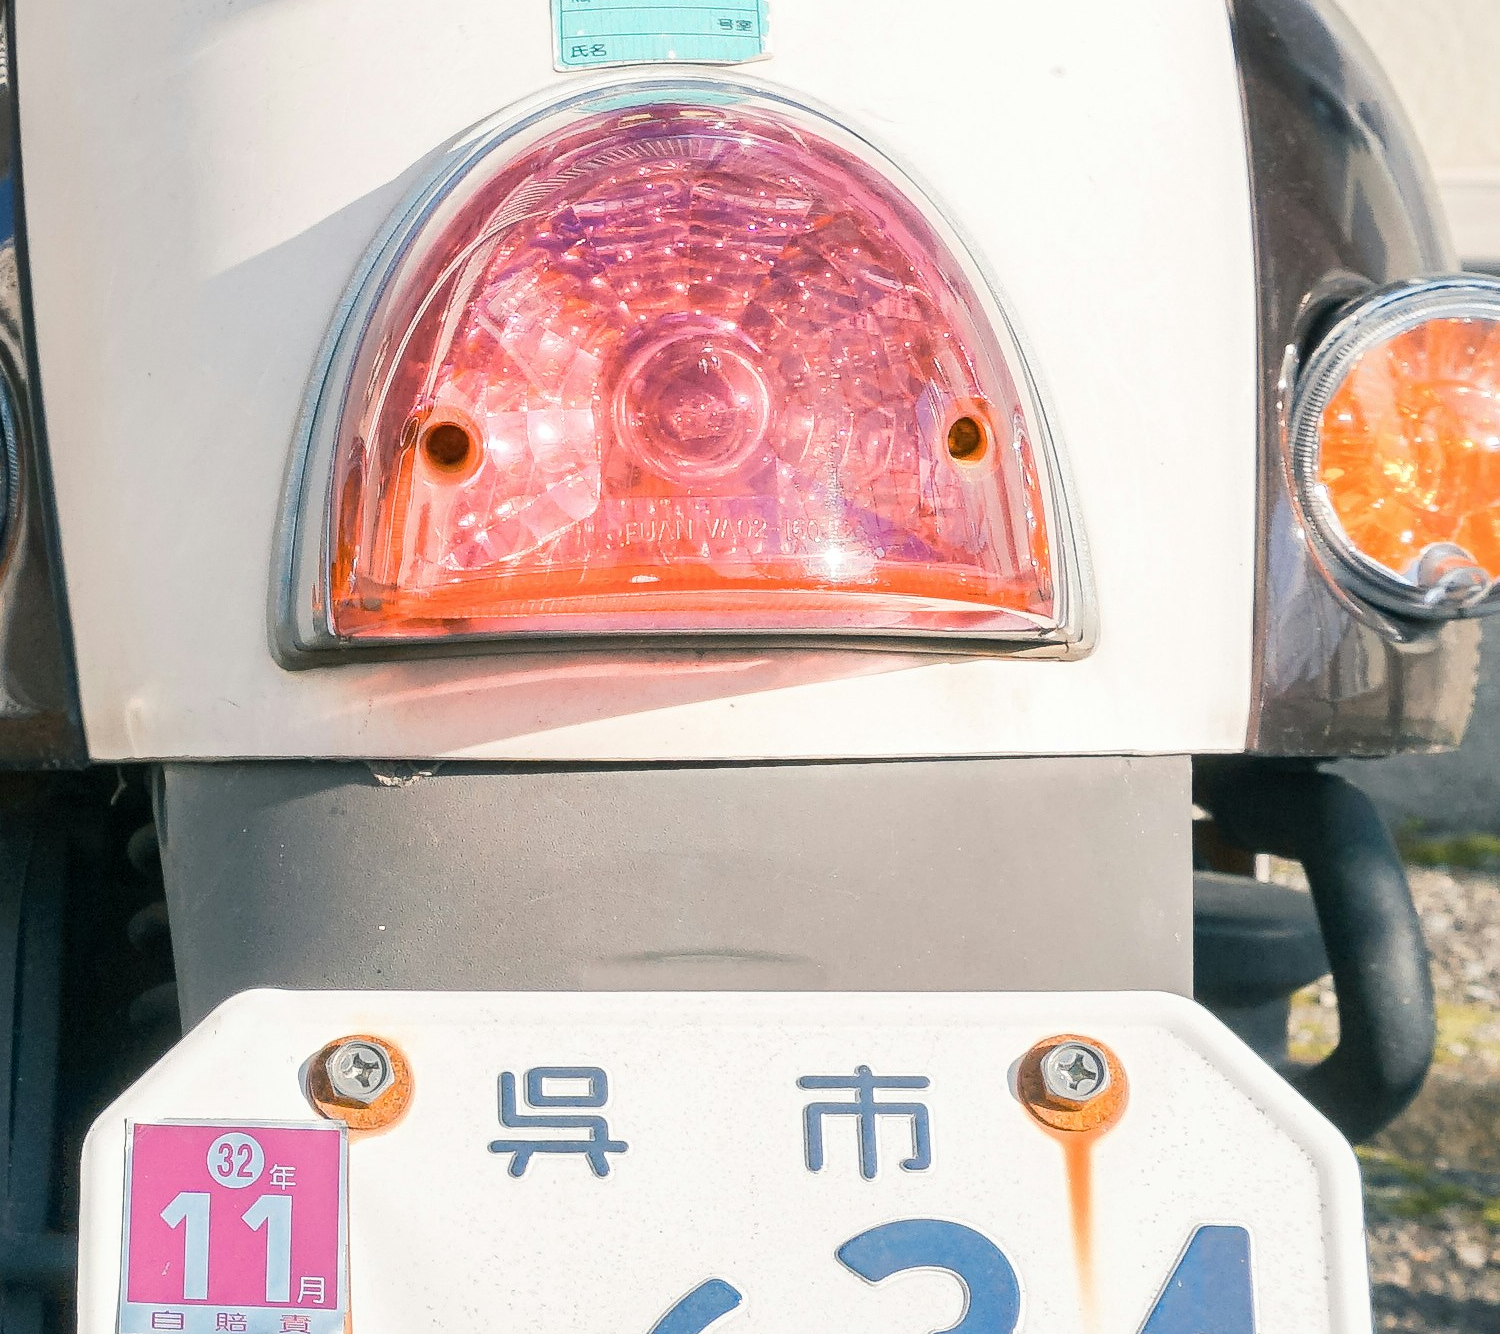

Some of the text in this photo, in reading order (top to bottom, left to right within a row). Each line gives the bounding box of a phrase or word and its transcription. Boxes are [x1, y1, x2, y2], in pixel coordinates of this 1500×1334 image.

[717, 18, 753, 32] 号室
[570, 43, 607, 58] 氏名
[151, 1310, 312, 1334] 自賠責
